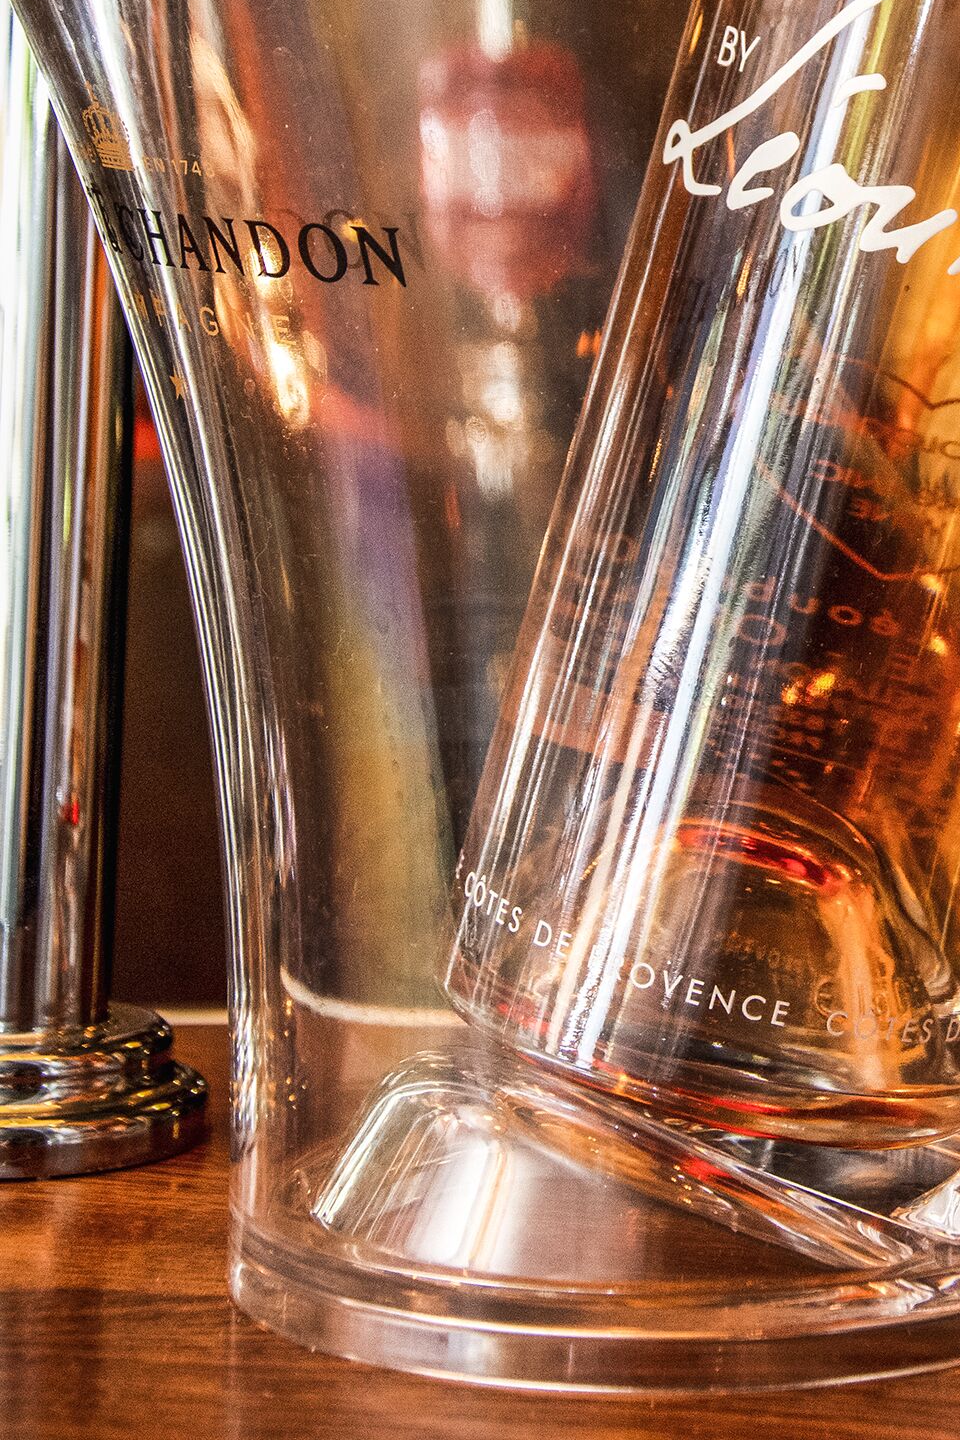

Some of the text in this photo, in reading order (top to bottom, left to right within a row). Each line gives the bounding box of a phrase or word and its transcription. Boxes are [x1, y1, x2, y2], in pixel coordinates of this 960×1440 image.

[716, 25, 761, 73] BY
[114, 202, 407, 288] CHANDON
[464, 871, 792, 1028] CÔTES DE OVENCE
